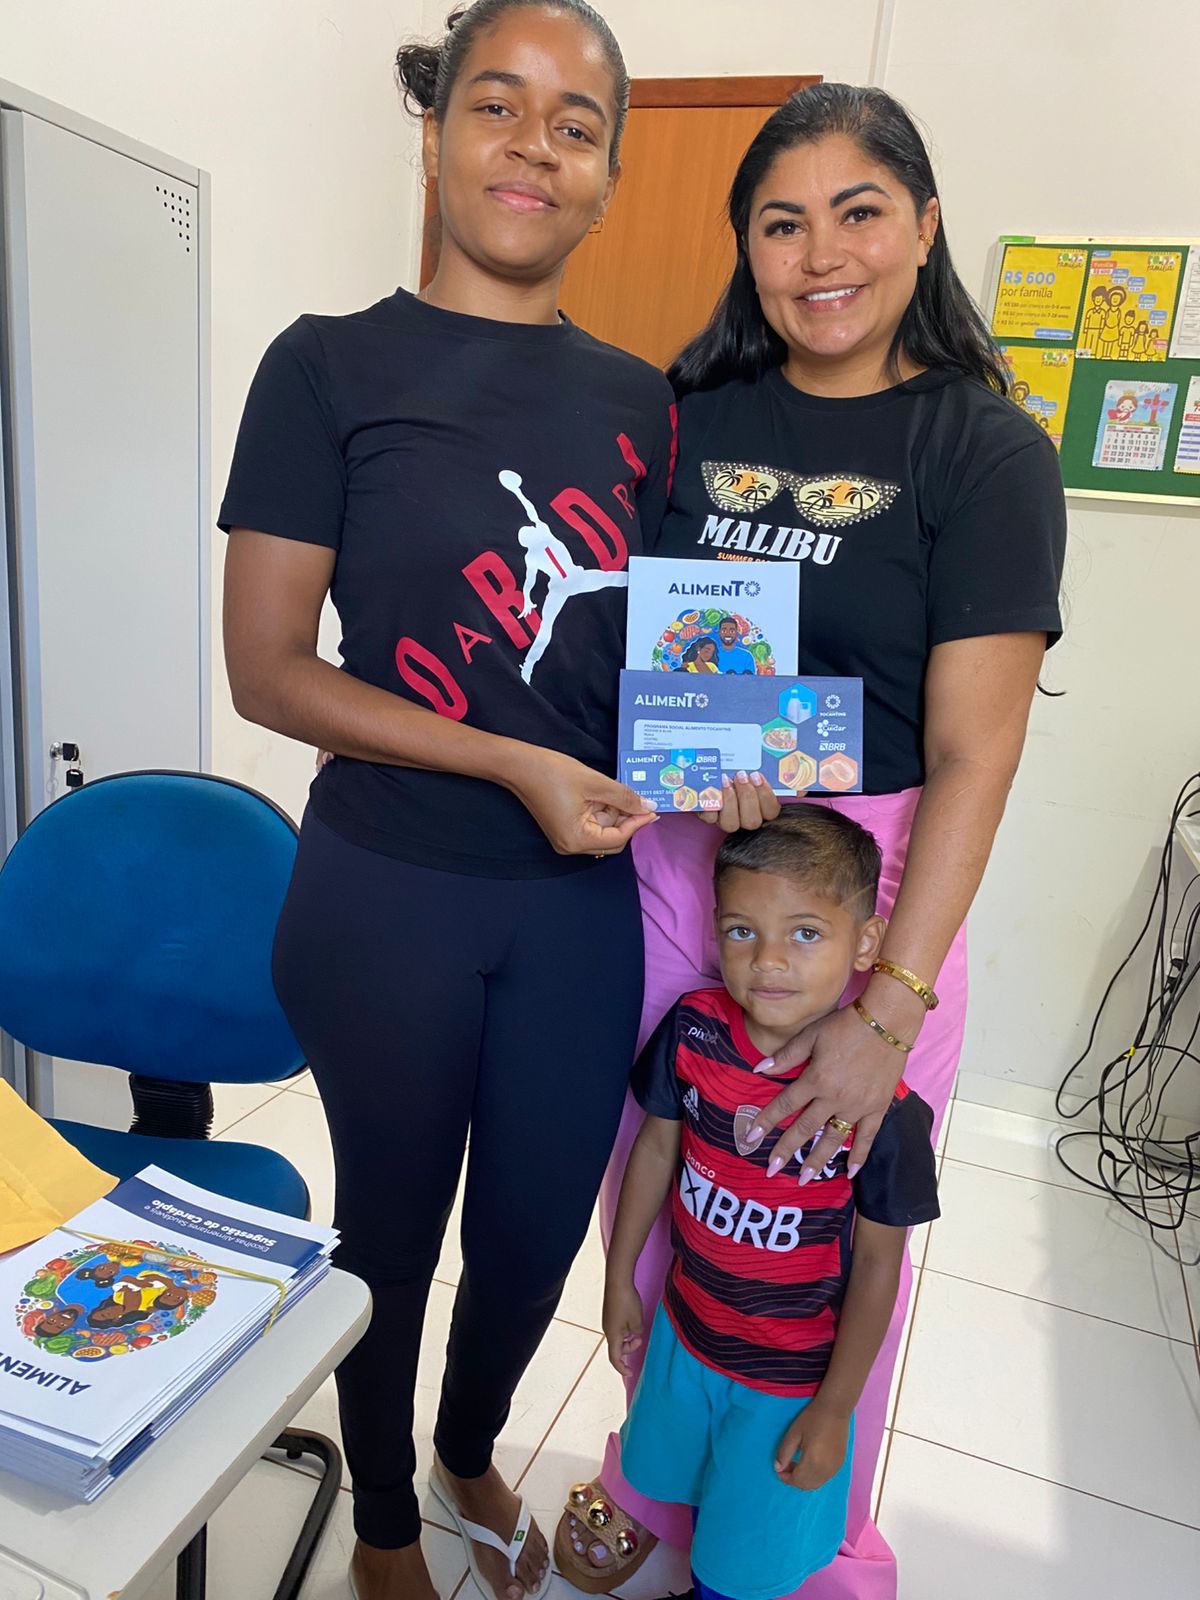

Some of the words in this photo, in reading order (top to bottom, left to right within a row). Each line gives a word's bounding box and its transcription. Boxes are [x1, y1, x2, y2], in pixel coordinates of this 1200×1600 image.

[1004, 270, 1022, 284] R$
[1026, 272, 1056, 285] 600
[1001, 288, 1018, 297] por
[697, 514, 843, 566] MALIBU
[828, 742, 847, 752] BRB
[698, 799, 721, 808] VISA
[686, 1148, 716, 1179] banco
[151, 1199, 203, 1226] Cardápio
[203, 1218, 220, 1229] de
[706, 1186, 803, 1253] BRB
[186, 1222, 238, 1246] Alimentares
[221, 1221, 278, 1247] Sugestão
[234, 1236, 271, 1253] Escolhas
[0, 1352, 92, 1396] ALIMEN
